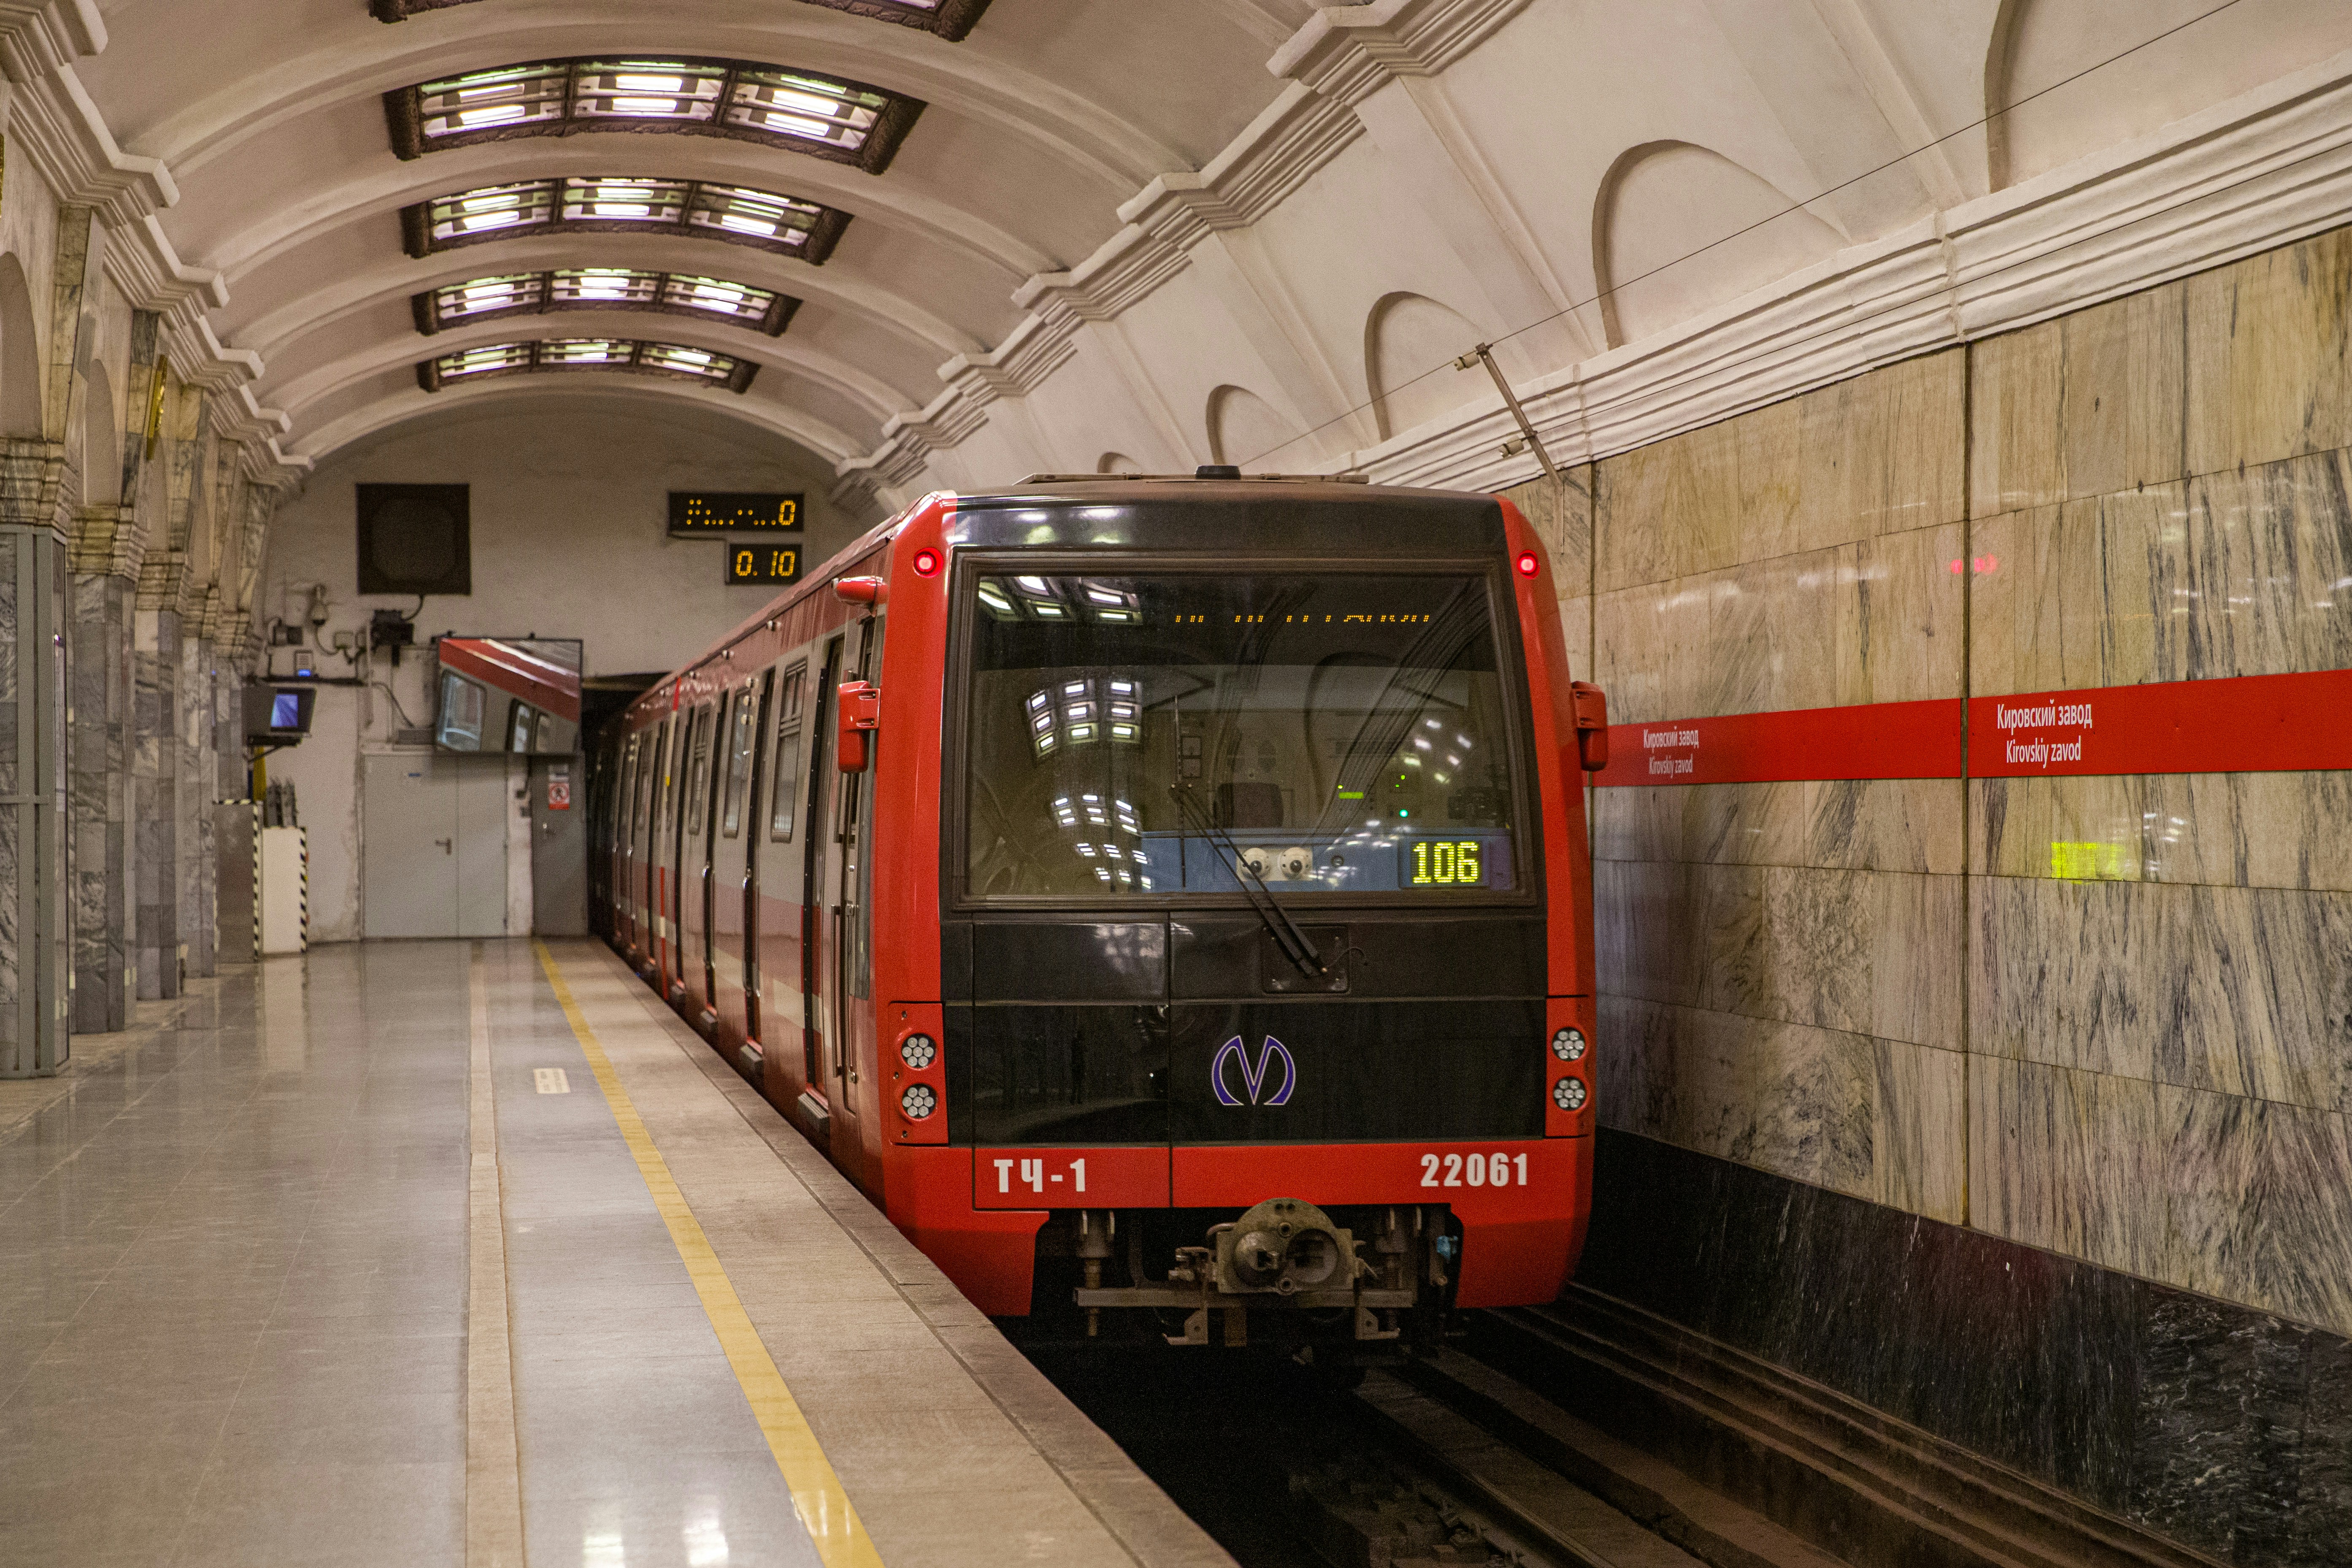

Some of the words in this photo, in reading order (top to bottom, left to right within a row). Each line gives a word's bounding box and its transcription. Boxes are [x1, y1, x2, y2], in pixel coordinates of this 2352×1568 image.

[1997, 699, 2055, 735] Кировский
[2058, 704, 2092, 729] завод
[1644, 725, 1678, 754] Кировский
[1679, 730, 1699, 749] завод
[2006, 737, 2049, 768] Kirovskiy
[2051, 735, 2081, 761] zavod
[1649, 755, 1674, 779] Kirovskiy
[1675, 754, 1693, 773] zavod
[1413, 842, 1478, 883] 106
[993, 1158, 1086, 1193] ТЧ-1
[1420, 1152, 1527, 1187] 22061
